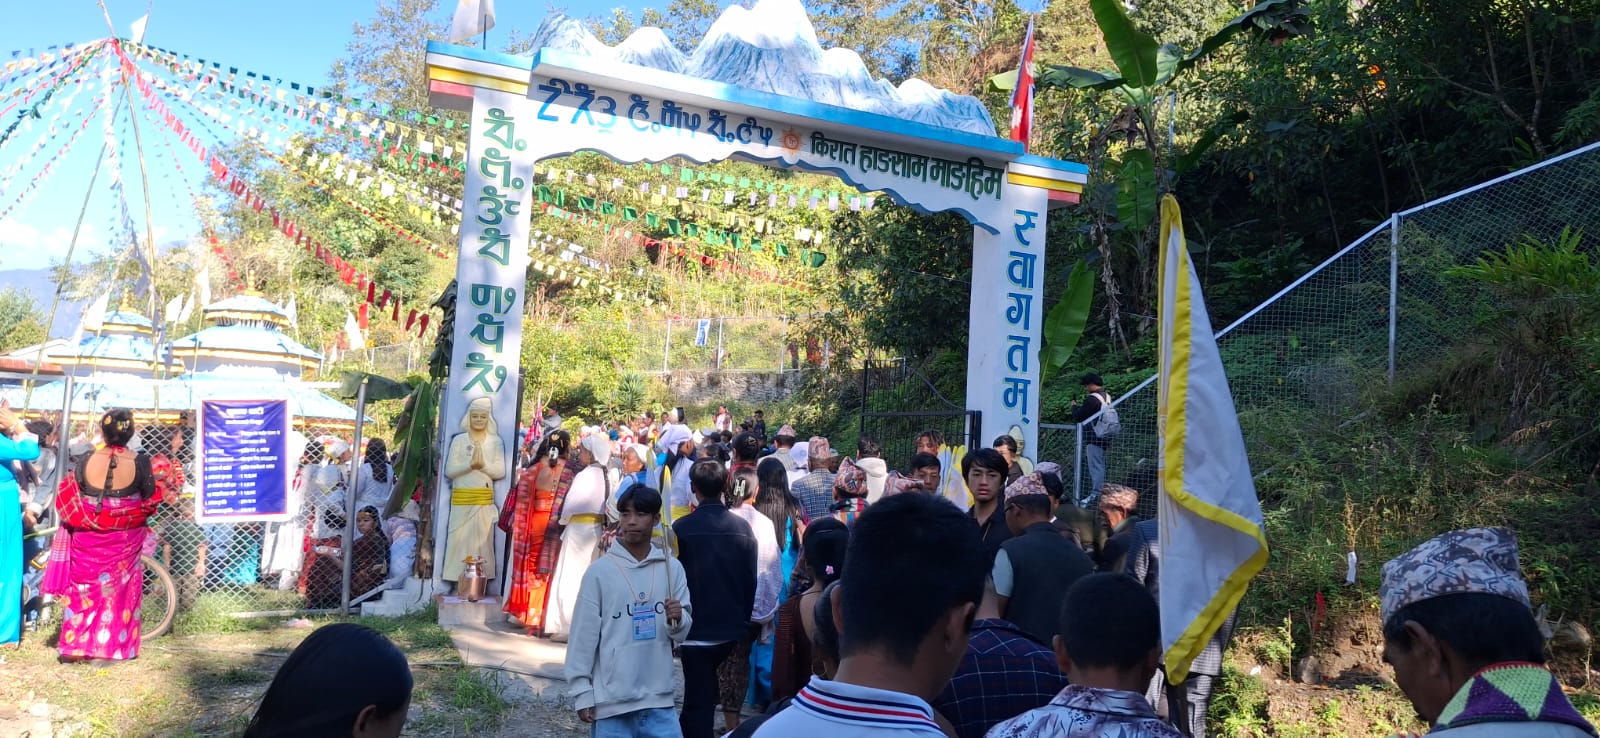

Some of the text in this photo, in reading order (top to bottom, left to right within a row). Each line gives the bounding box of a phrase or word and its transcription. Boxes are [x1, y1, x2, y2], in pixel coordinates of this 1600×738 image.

[810, 131, 1005, 200] किरात हाङसाम माङहिम
